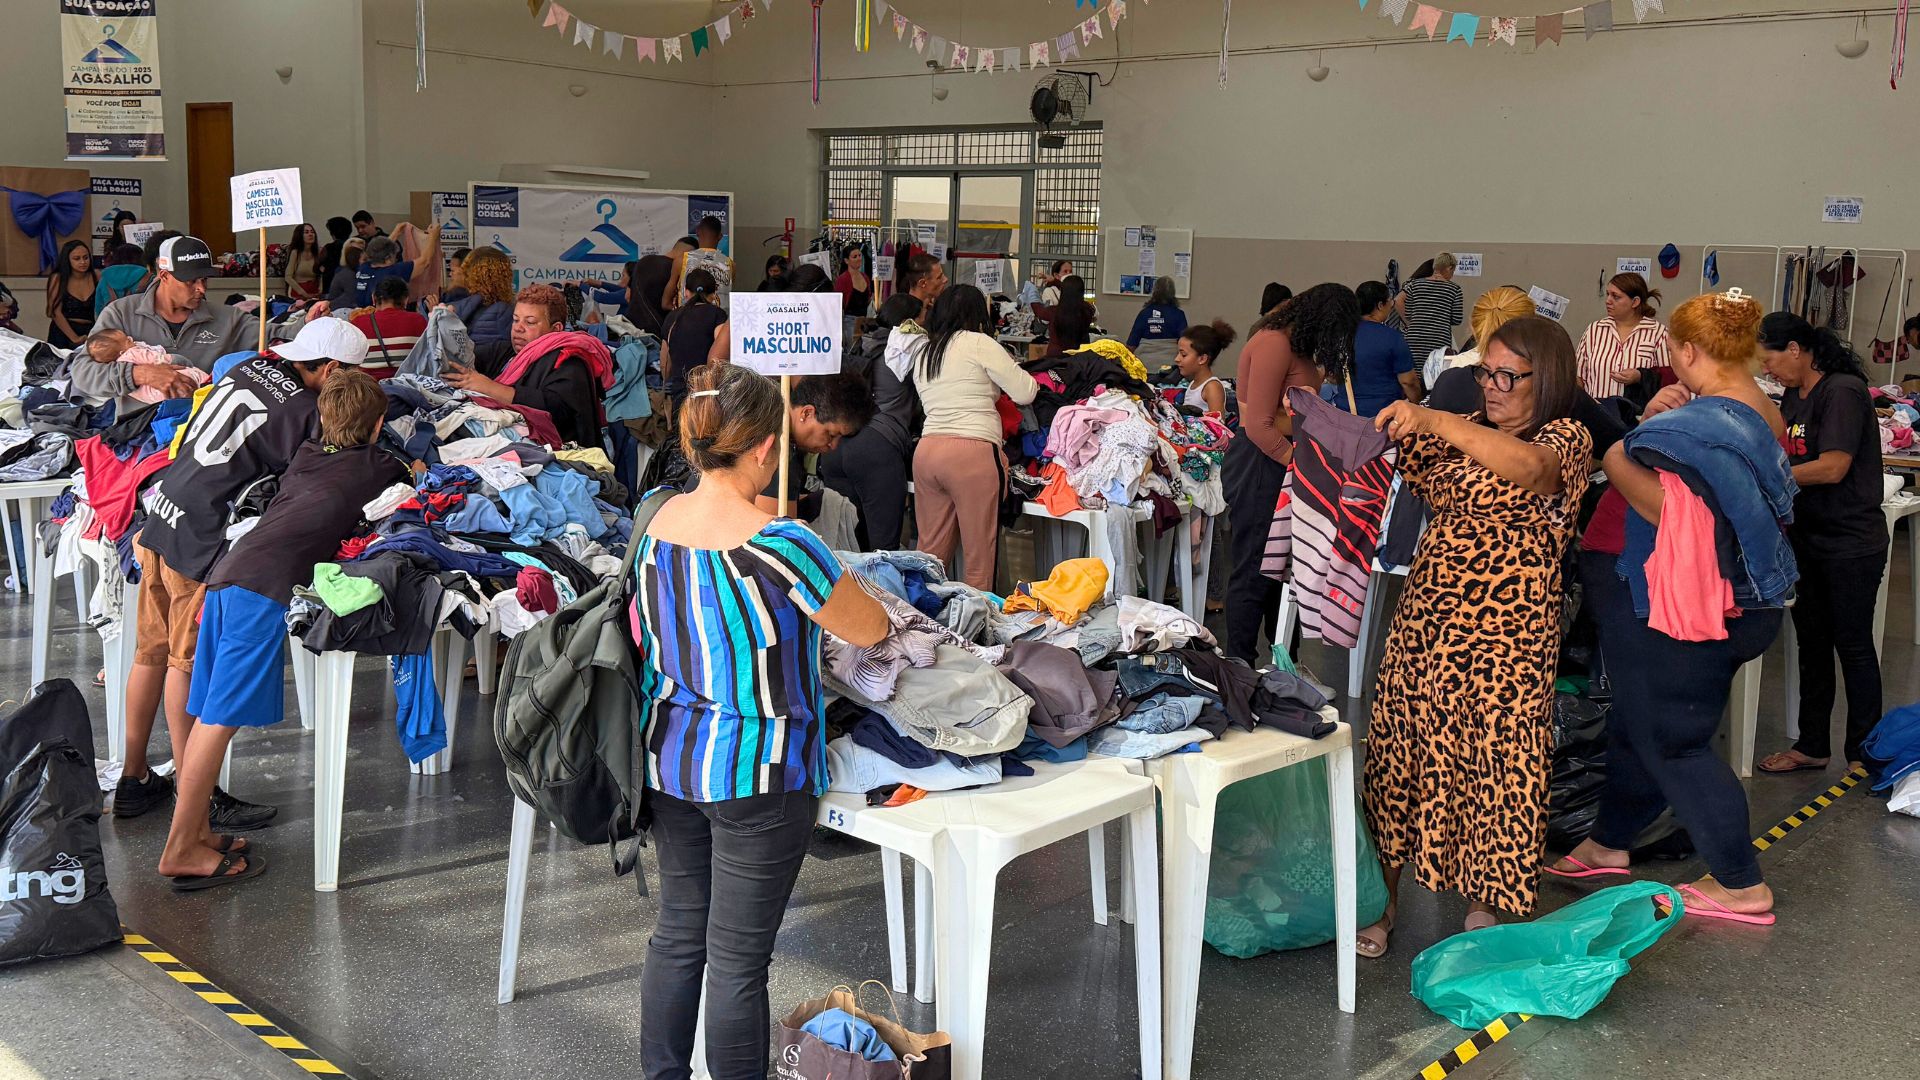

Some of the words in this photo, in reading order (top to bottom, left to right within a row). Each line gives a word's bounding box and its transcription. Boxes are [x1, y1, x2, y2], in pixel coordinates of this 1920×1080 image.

[65, 0, 93, 8] SUA
[96, 0, 151, 11] DOAÇÃO
[71, 65, 114, 73] CAMPANHA
[71, 72, 153, 86] AGASALHO
[93, 179, 111, 187] FAÇA
[110, 186, 139, 194] DOAÇÃO
[246, 187, 279, 199] CAMISETA
[246, 198, 283, 210] MASCULINA
[477, 203, 501, 211] NOVA
[246, 210, 254, 219] DE
[1620, 264, 1647, 272] CALÇADO
[523, 267, 607, 281] CAMPANHA
[611, 270, 622, 281] D
[767, 306, 809, 314] AGASALHO
[767, 322, 810, 336] SHORT
[743, 336, 832, 354] MASCULINO
[240, 365, 287, 404] smartphones
[0, 867, 85, 904] tng
